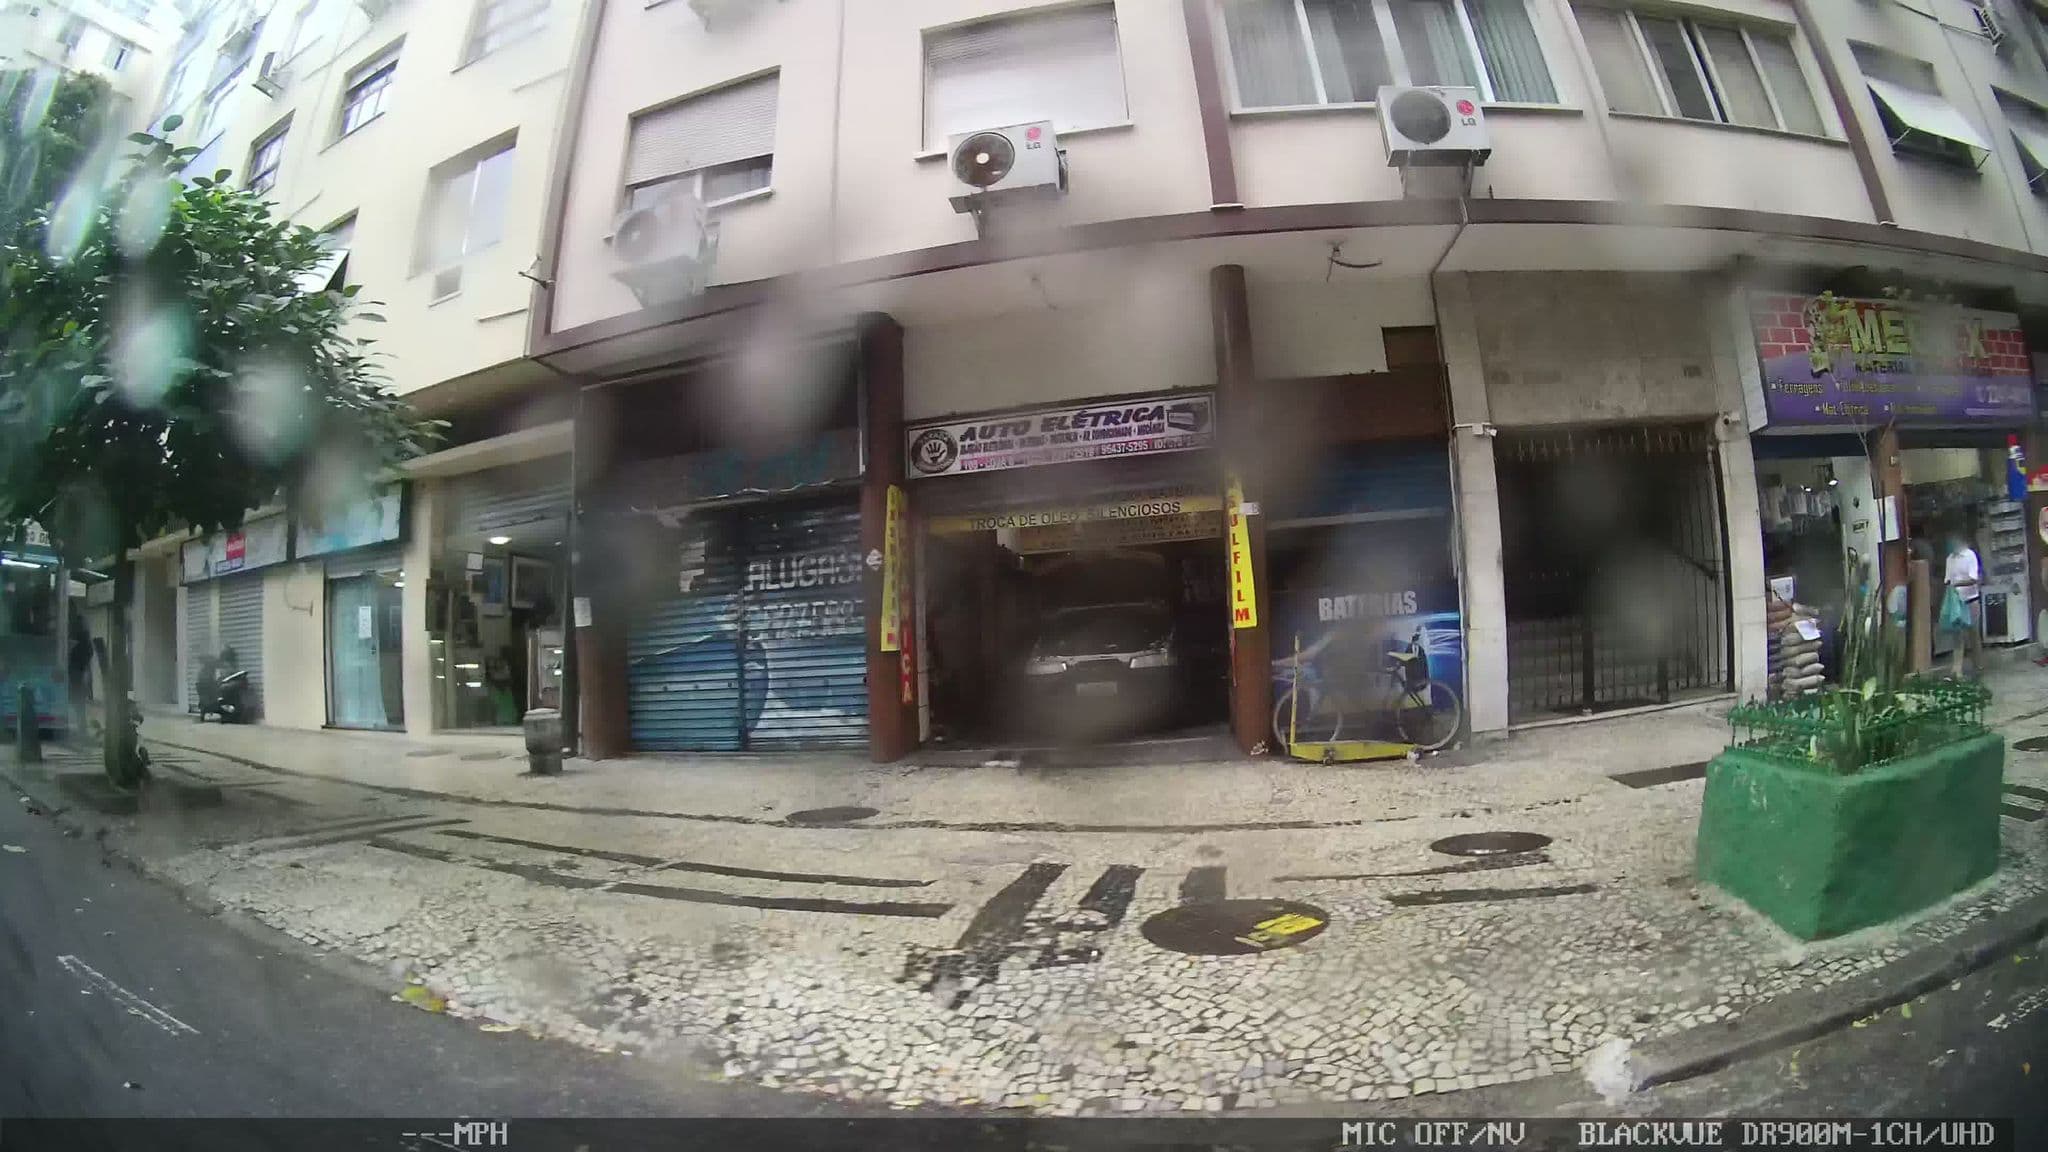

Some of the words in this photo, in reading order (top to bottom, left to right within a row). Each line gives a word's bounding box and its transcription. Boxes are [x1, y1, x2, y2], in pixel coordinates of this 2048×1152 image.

[1461, 118, 1477, 127] LG
[1026, 141, 1041, 150] LG
[960, 419, 1032, 442] AUTO
[1041, 404, 1166, 433] ELÉTRICA
[970, 515, 1015, 530] TROCA
[1019, 514, 1037, 527] DE
